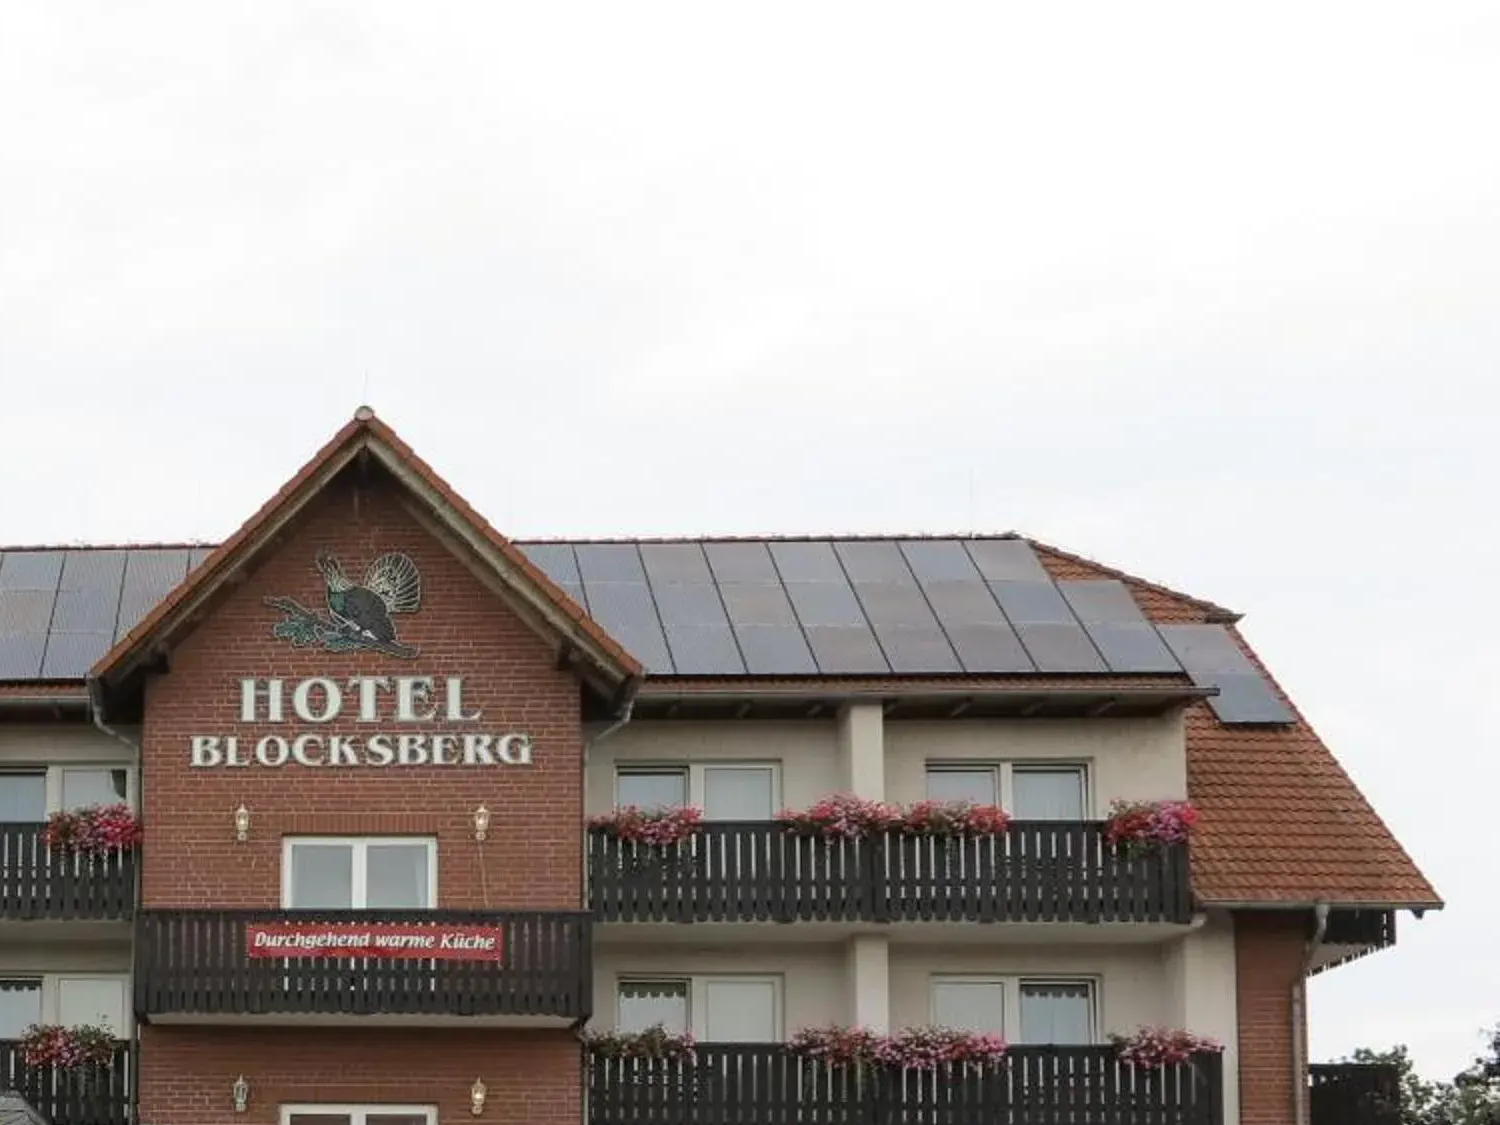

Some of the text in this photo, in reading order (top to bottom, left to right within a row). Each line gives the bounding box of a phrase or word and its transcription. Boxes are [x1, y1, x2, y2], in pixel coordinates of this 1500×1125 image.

[239, 676, 482, 724] HOTEL
[189, 733, 533, 768] BLOCKSBERG
[254, 931, 495, 949] Durchgehend warme Küche
